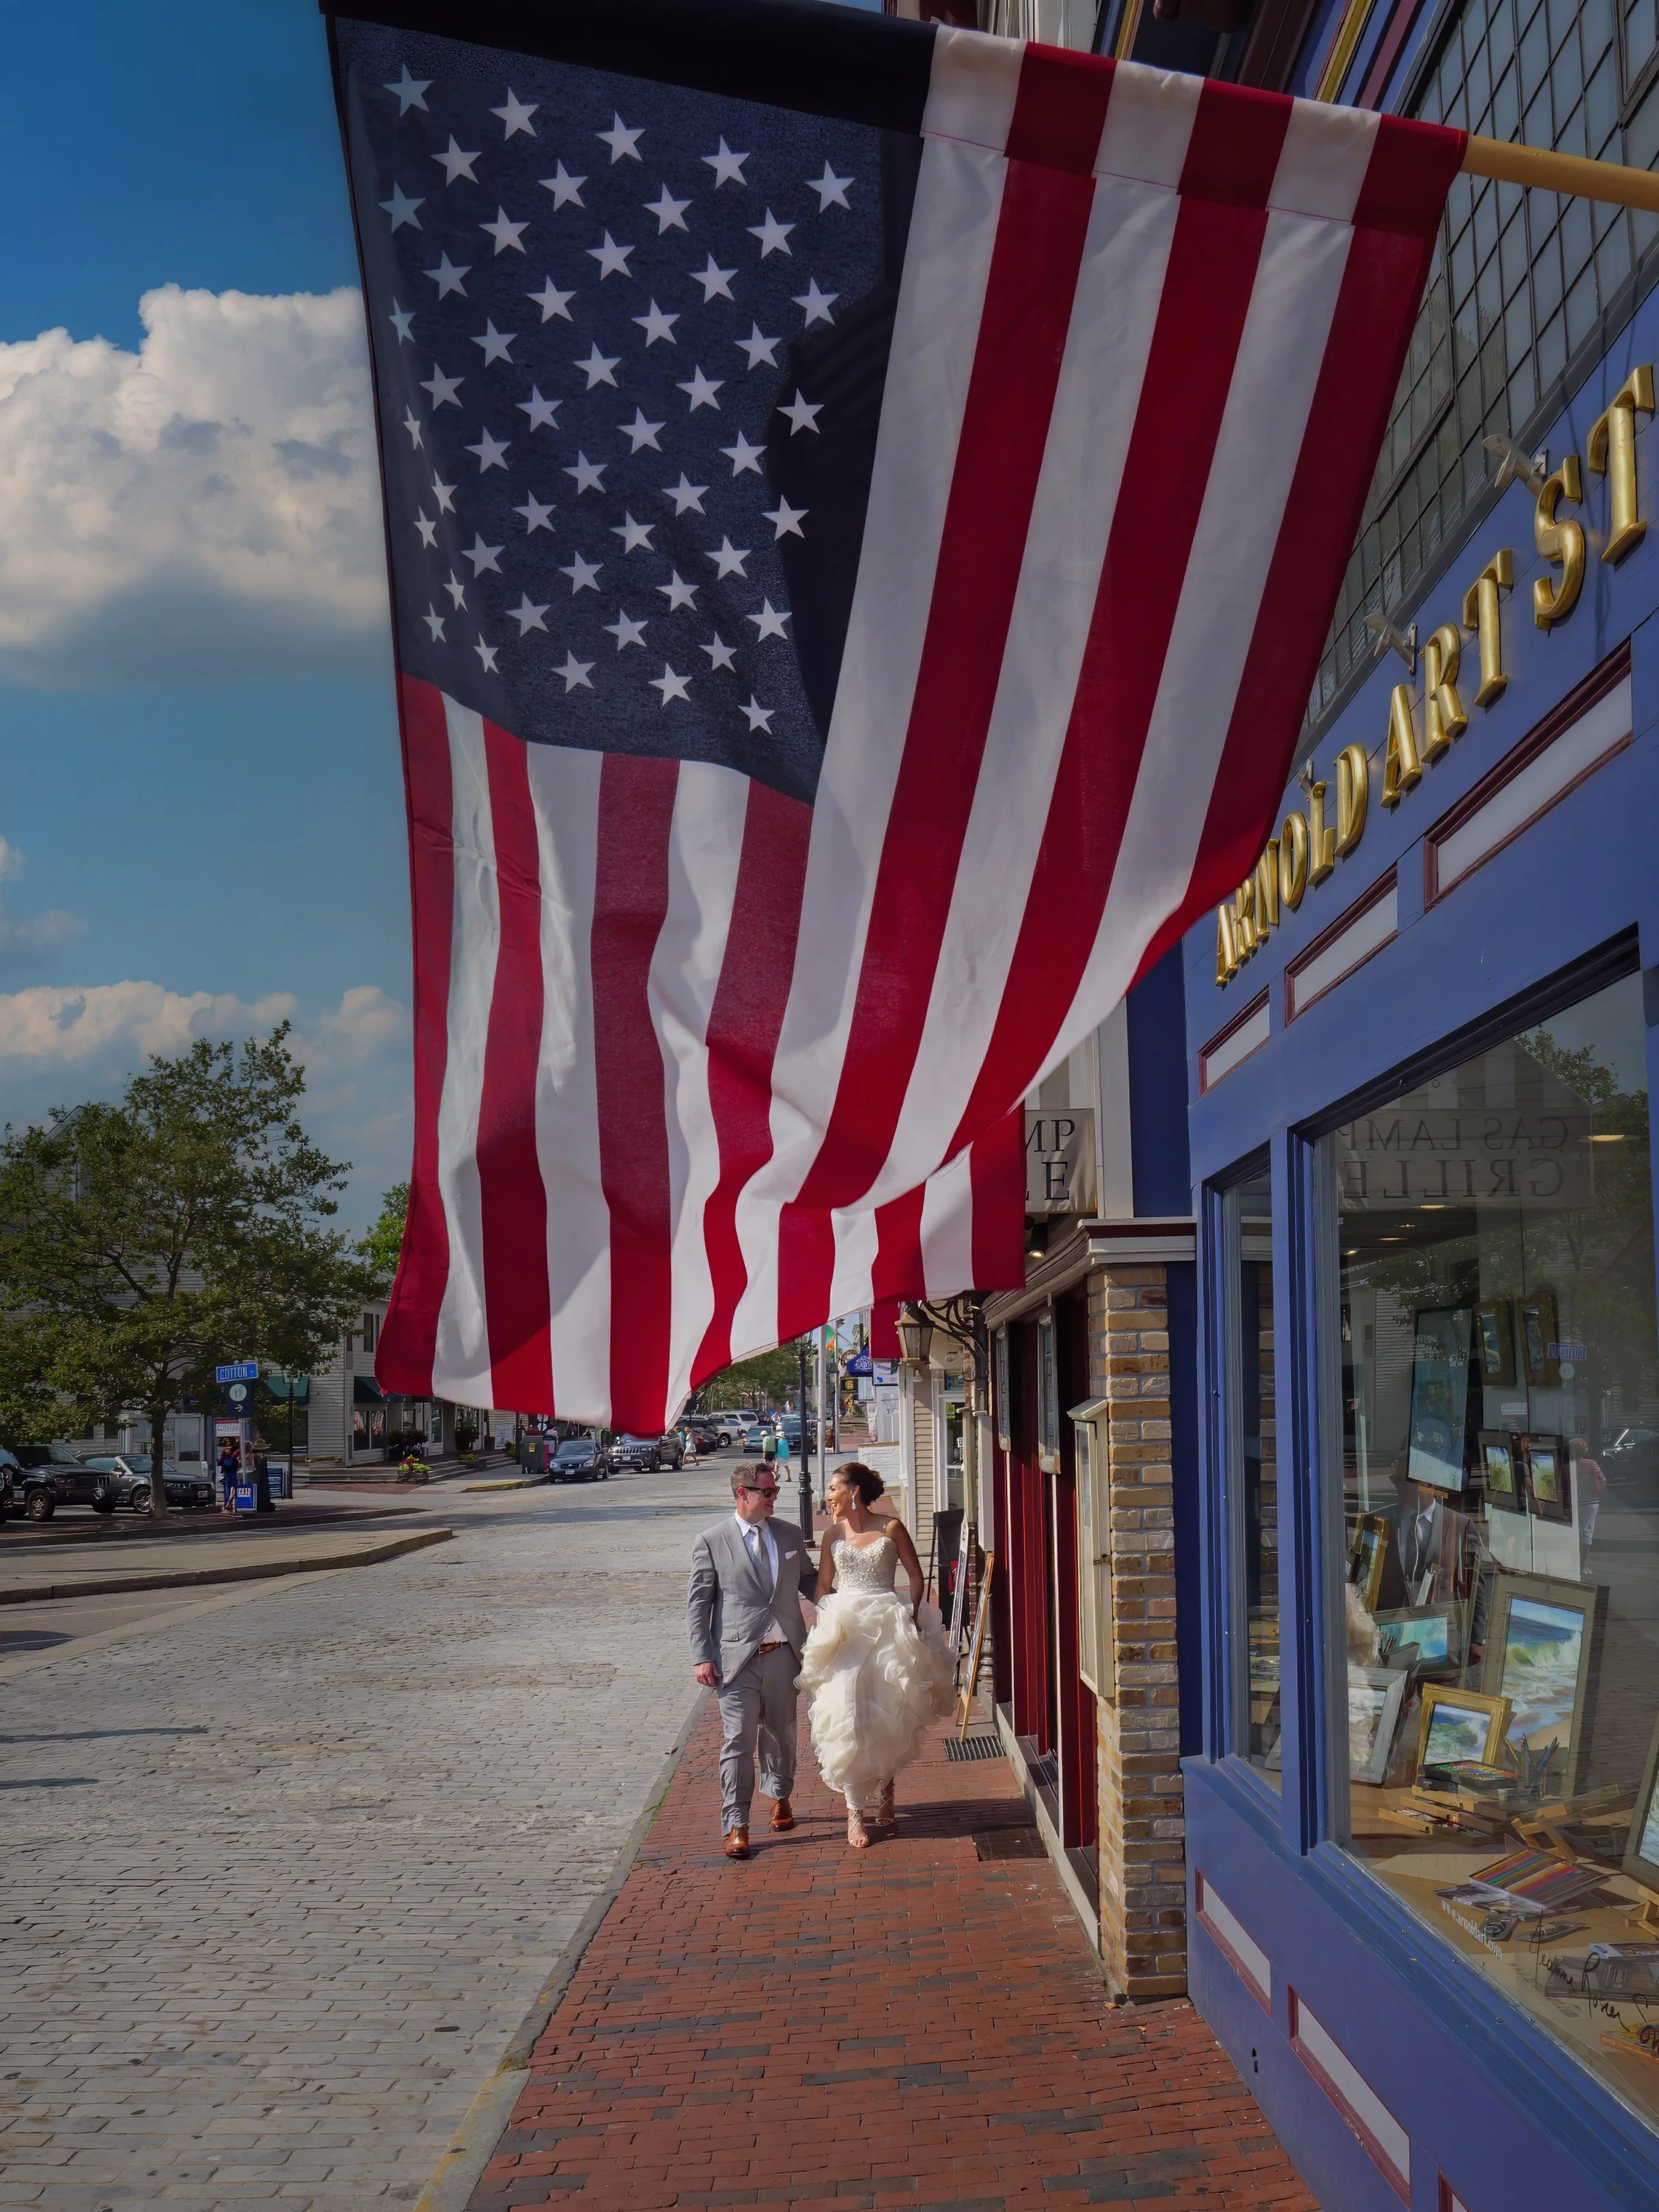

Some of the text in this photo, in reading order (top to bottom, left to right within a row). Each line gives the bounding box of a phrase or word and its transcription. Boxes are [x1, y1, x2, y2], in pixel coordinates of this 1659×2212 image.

[1215, 364, 1655, 990] ARNOLD ART ST
